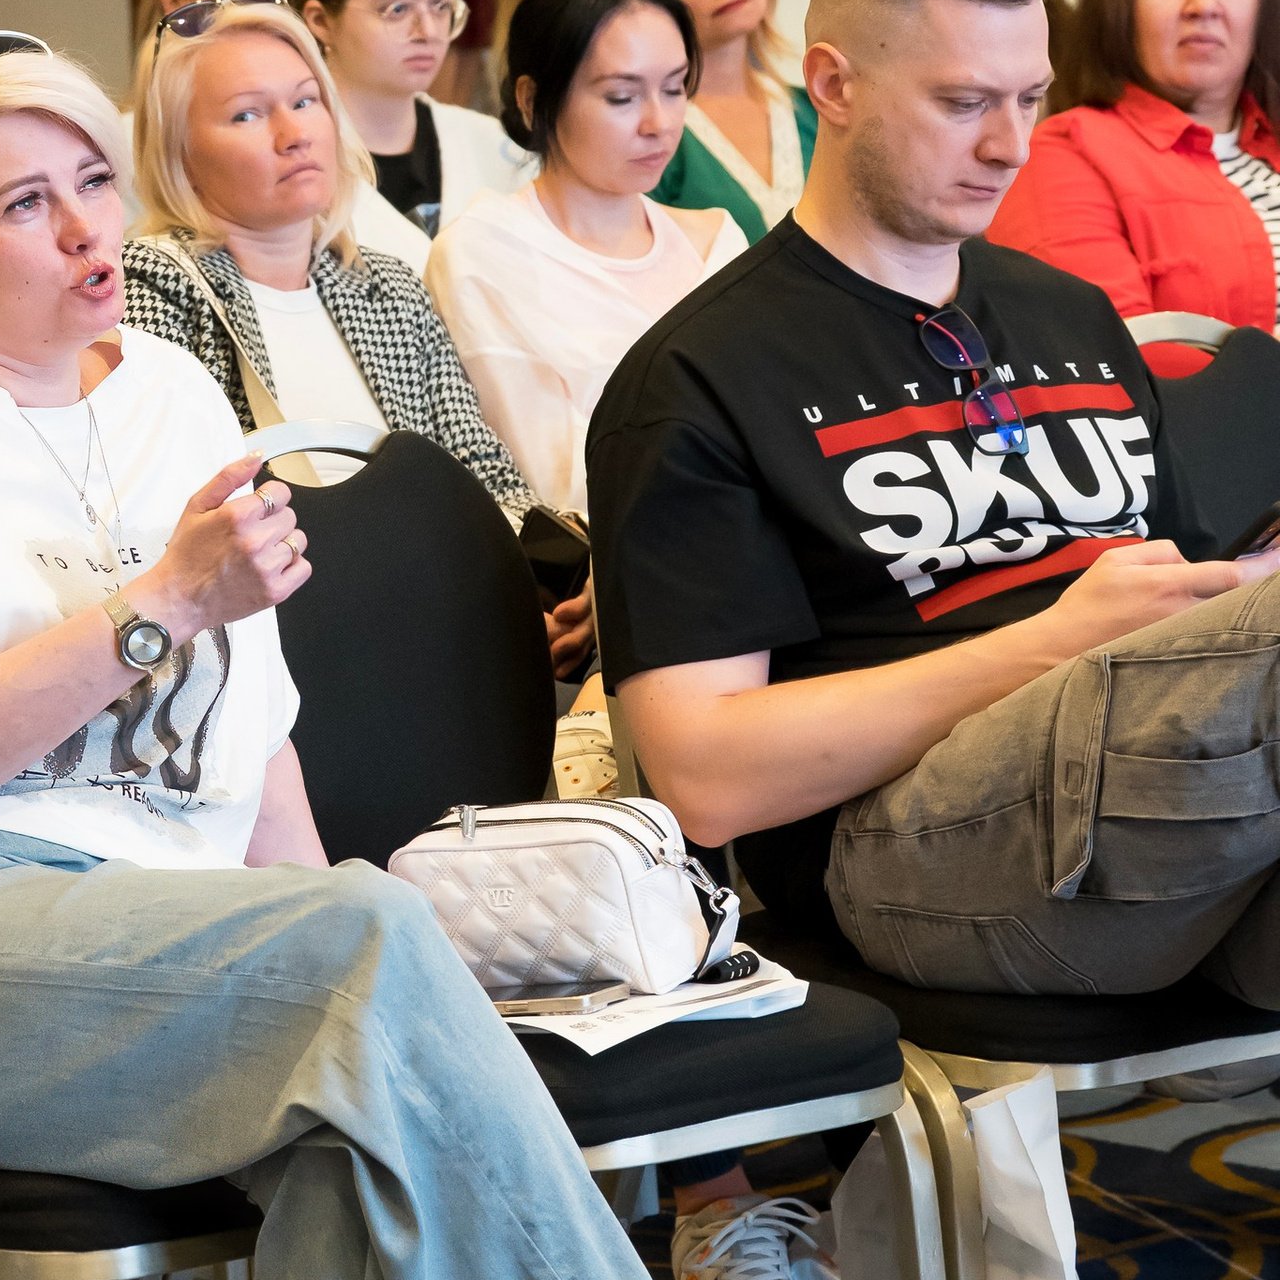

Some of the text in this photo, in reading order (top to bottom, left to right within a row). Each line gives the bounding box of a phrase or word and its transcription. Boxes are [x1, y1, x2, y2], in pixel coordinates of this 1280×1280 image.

[803, 362, 1115, 423] ULTIMATE
[842, 415, 1156, 555] SKUF
[36, 552, 68, 570] TO
